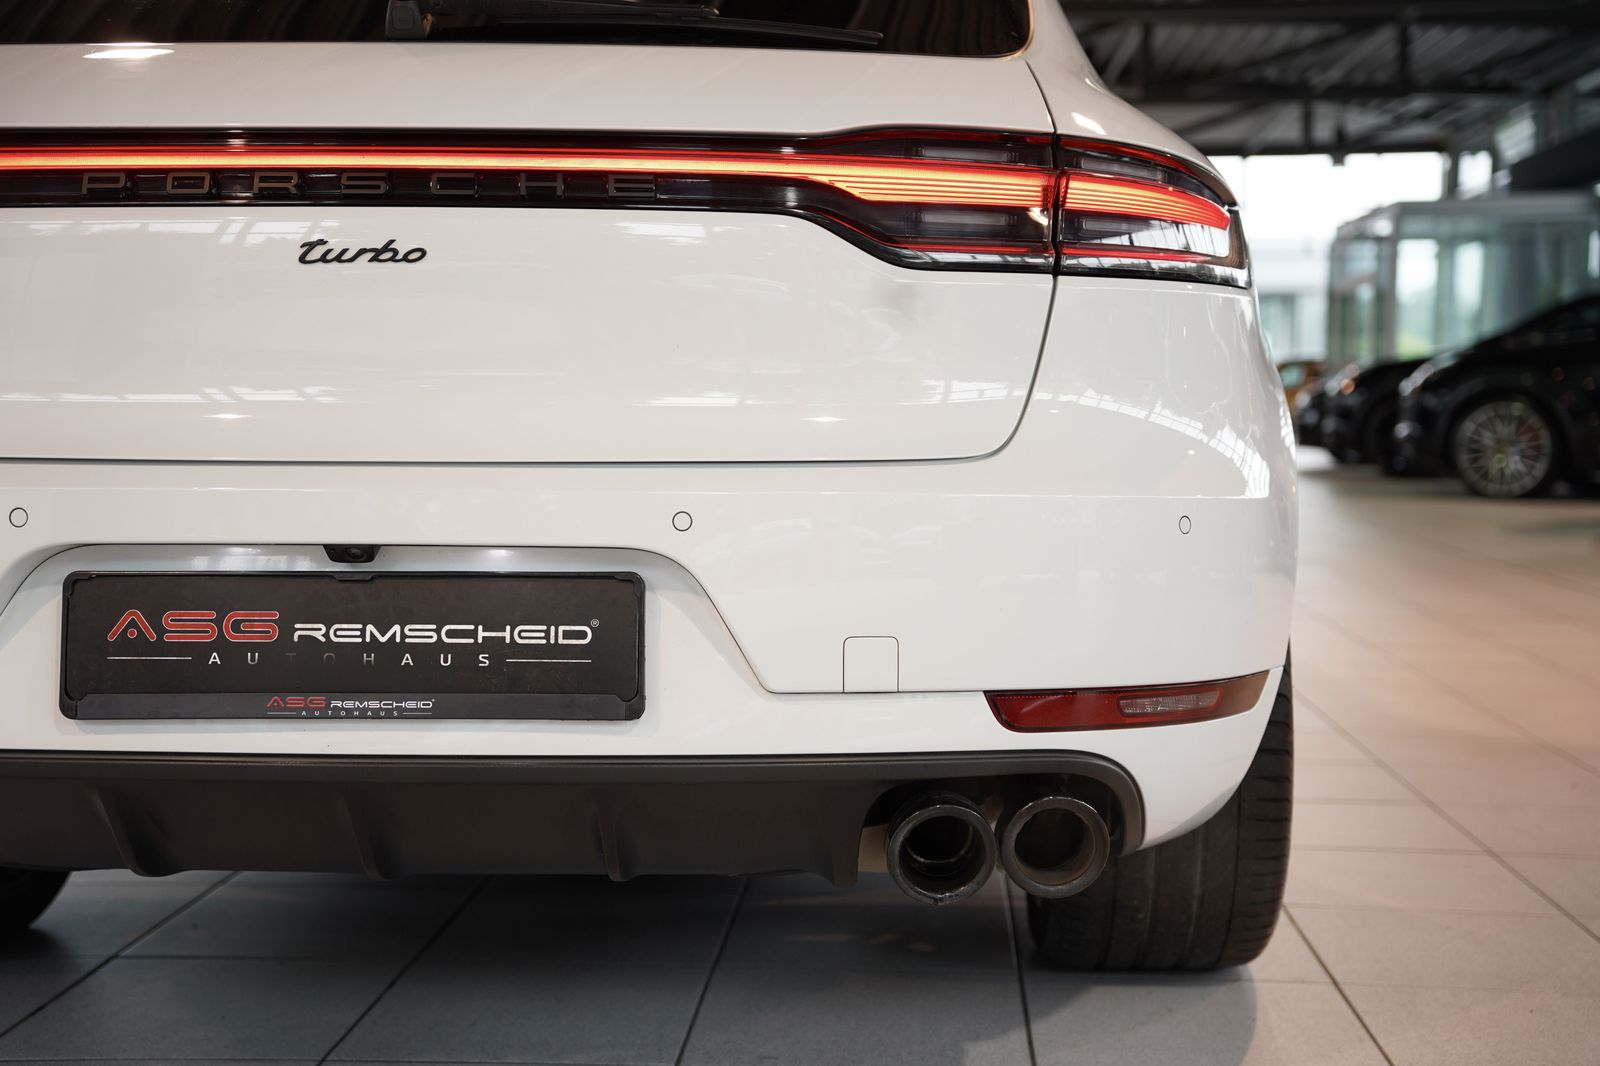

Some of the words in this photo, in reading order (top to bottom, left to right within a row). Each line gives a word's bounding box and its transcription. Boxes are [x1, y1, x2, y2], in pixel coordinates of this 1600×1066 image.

[81, 171, 657, 197] PORSCHE
[298, 238, 427, 265] turbo
[107, 609, 279, 642] ASG
[267, 696, 326, 709] ASG
